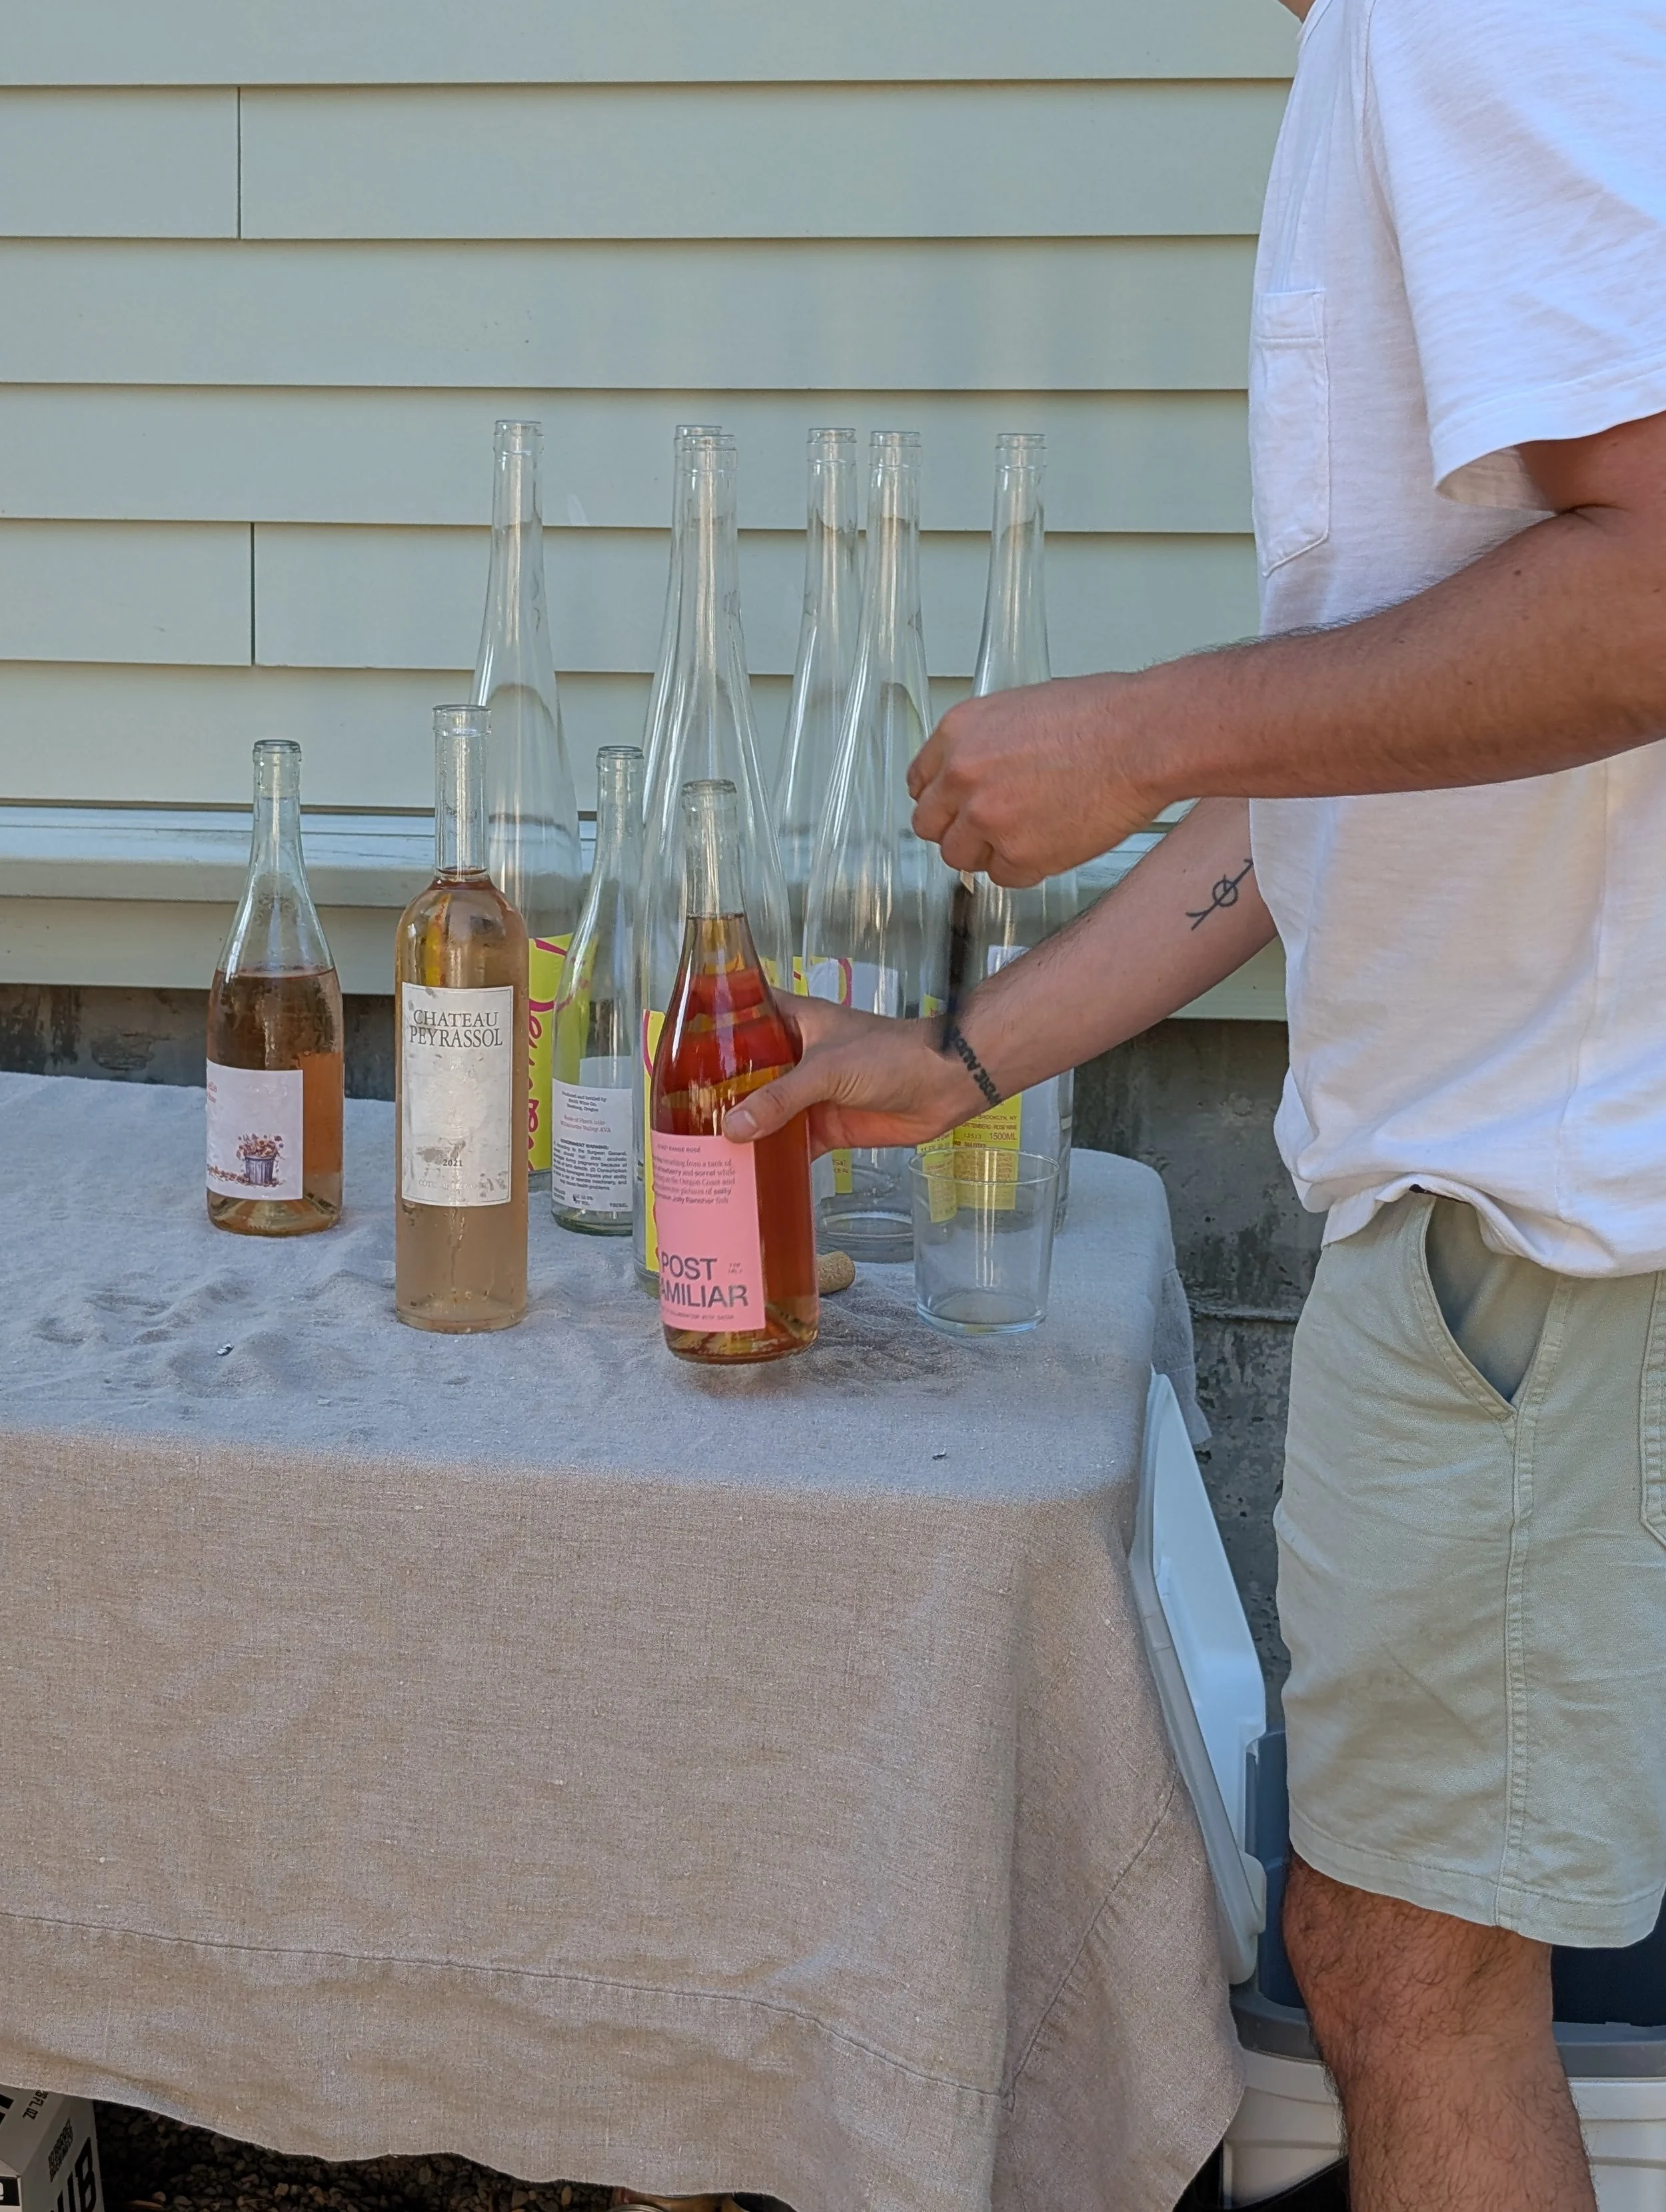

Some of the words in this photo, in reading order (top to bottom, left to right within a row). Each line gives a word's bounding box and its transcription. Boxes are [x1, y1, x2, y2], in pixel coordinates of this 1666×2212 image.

[409, 1025, 503, 1048] PEYRASSOL
[990, 1132, 1018, 1141] 1500ML
[442, 1158, 463, 1167] 2021
[661, 1251, 718, 1281] POST
